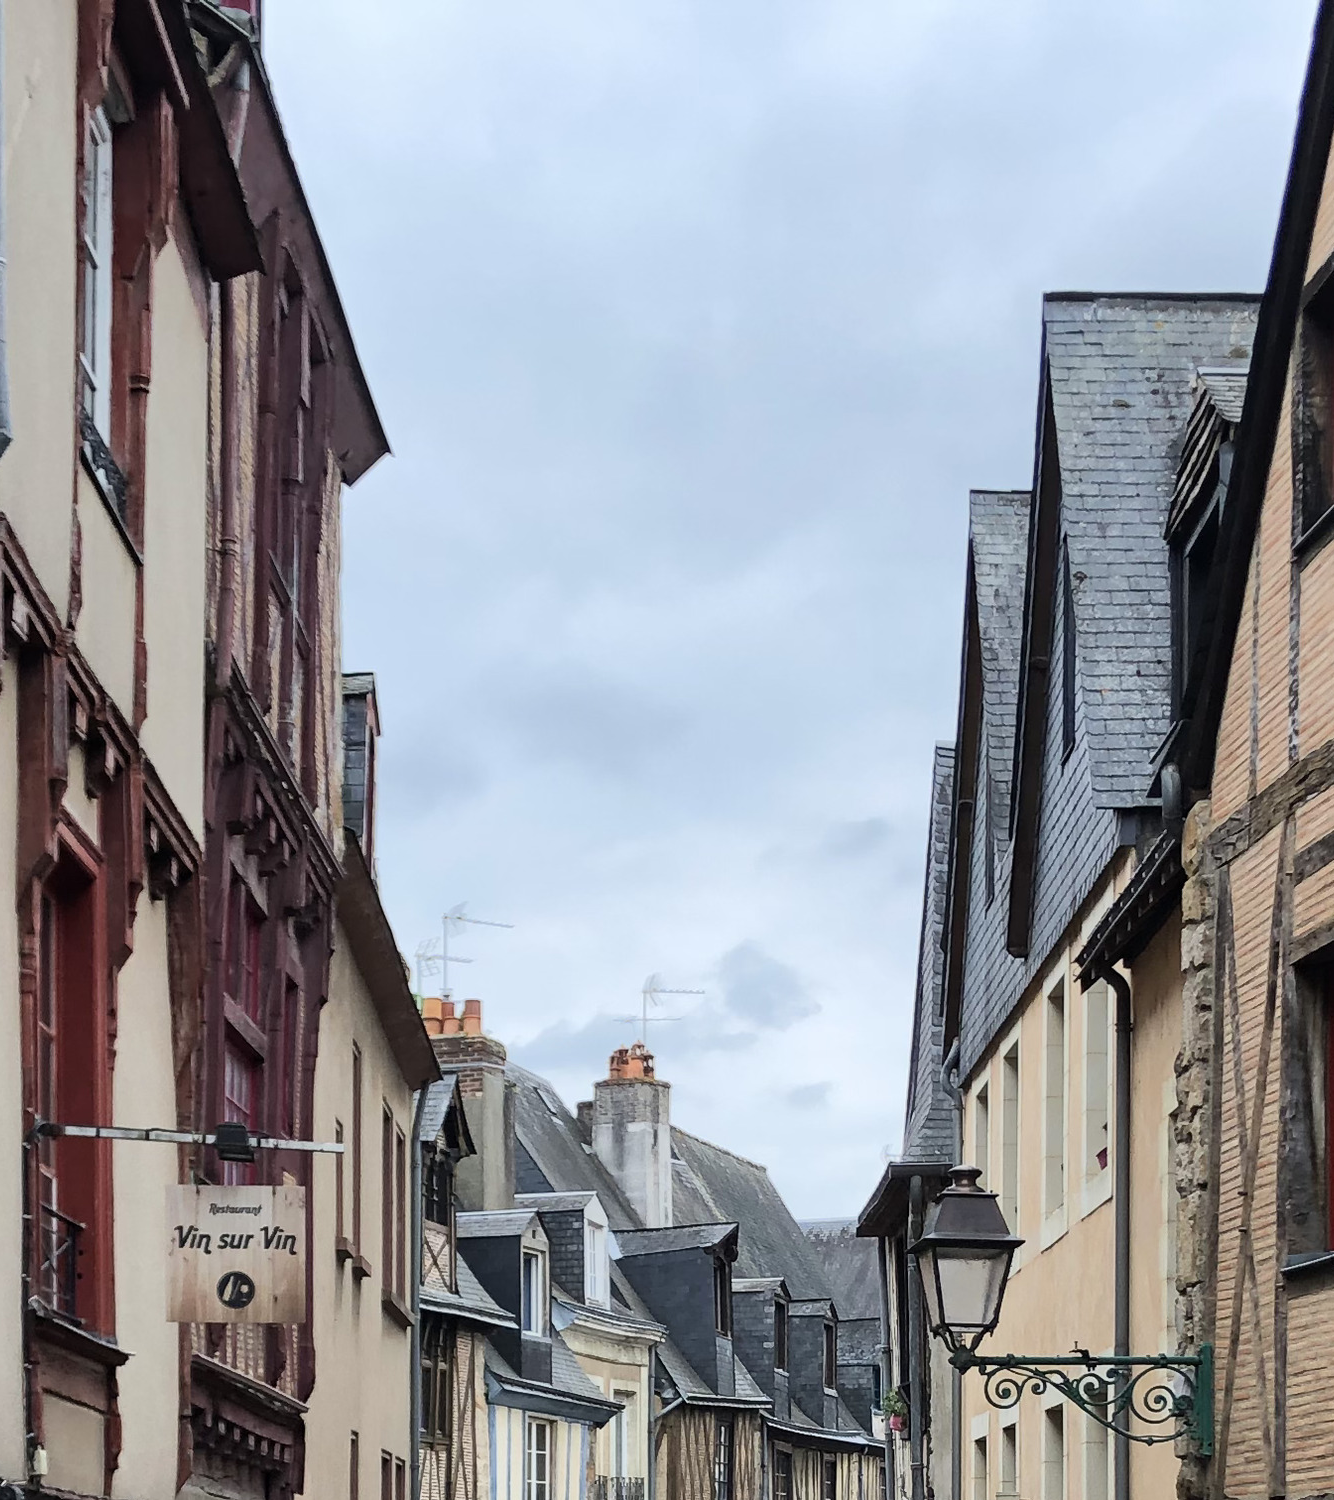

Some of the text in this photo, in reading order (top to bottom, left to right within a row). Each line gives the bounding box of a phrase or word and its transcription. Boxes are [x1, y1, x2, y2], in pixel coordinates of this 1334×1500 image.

[209, 1203, 262, 1216] Restaurant
[174, 1225, 297, 1256] Vin sur Vin
